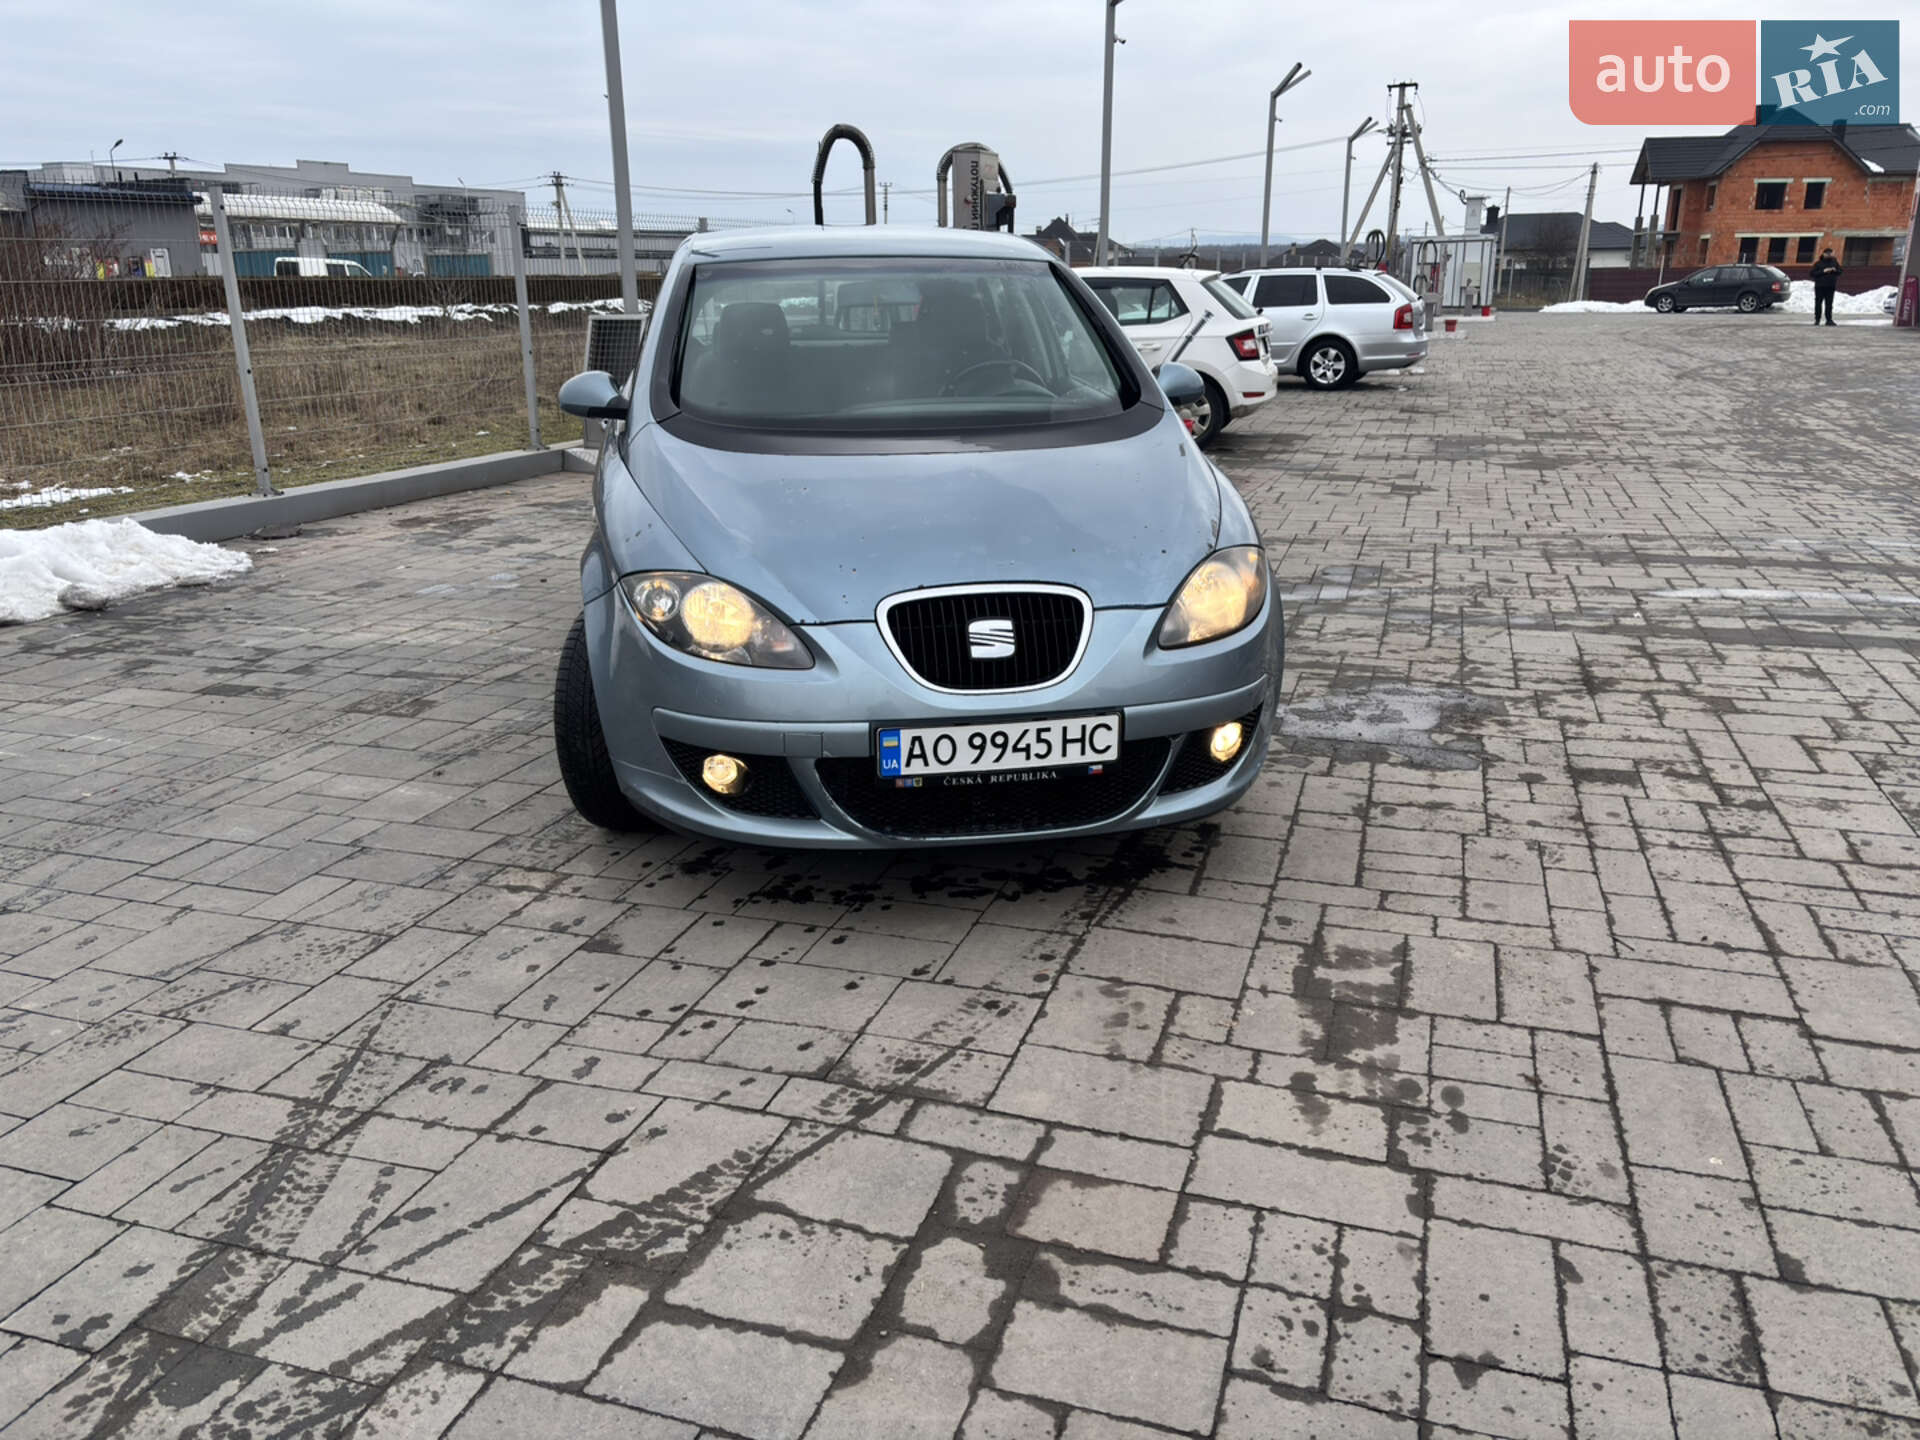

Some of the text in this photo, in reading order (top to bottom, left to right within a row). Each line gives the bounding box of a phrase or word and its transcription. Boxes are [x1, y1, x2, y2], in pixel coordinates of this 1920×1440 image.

[905, 723, 1113, 768] AO 9945 HC
[882, 759, 899, 770] UA
[990, 770, 1057, 784] REPUBLIKA
